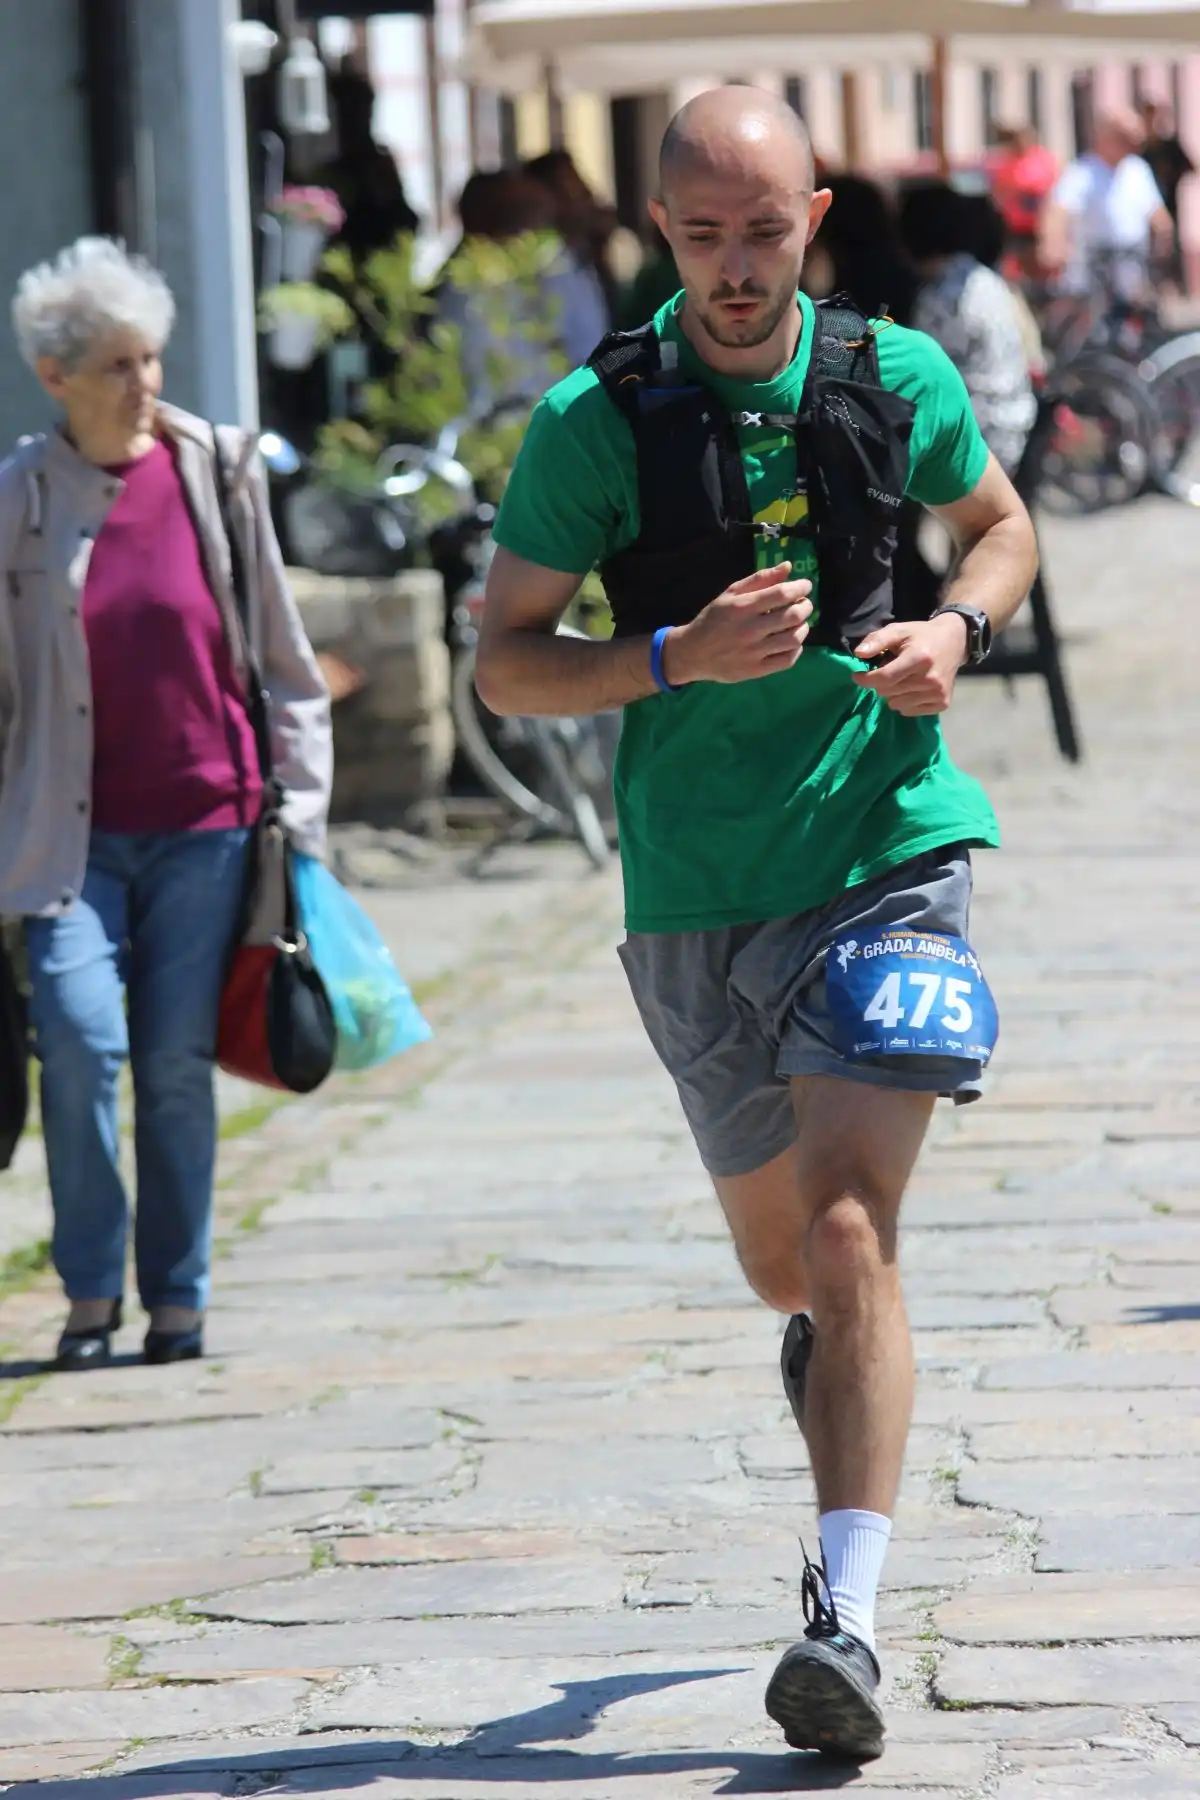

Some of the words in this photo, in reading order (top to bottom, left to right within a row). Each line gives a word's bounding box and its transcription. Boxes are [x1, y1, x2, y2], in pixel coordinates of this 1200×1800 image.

[867, 487, 902, 508] EVADICT
[864, 939, 913, 959] GRADA
[917, 940, 966, 967] ANĐELA
[864, 972, 973, 1033] 475
